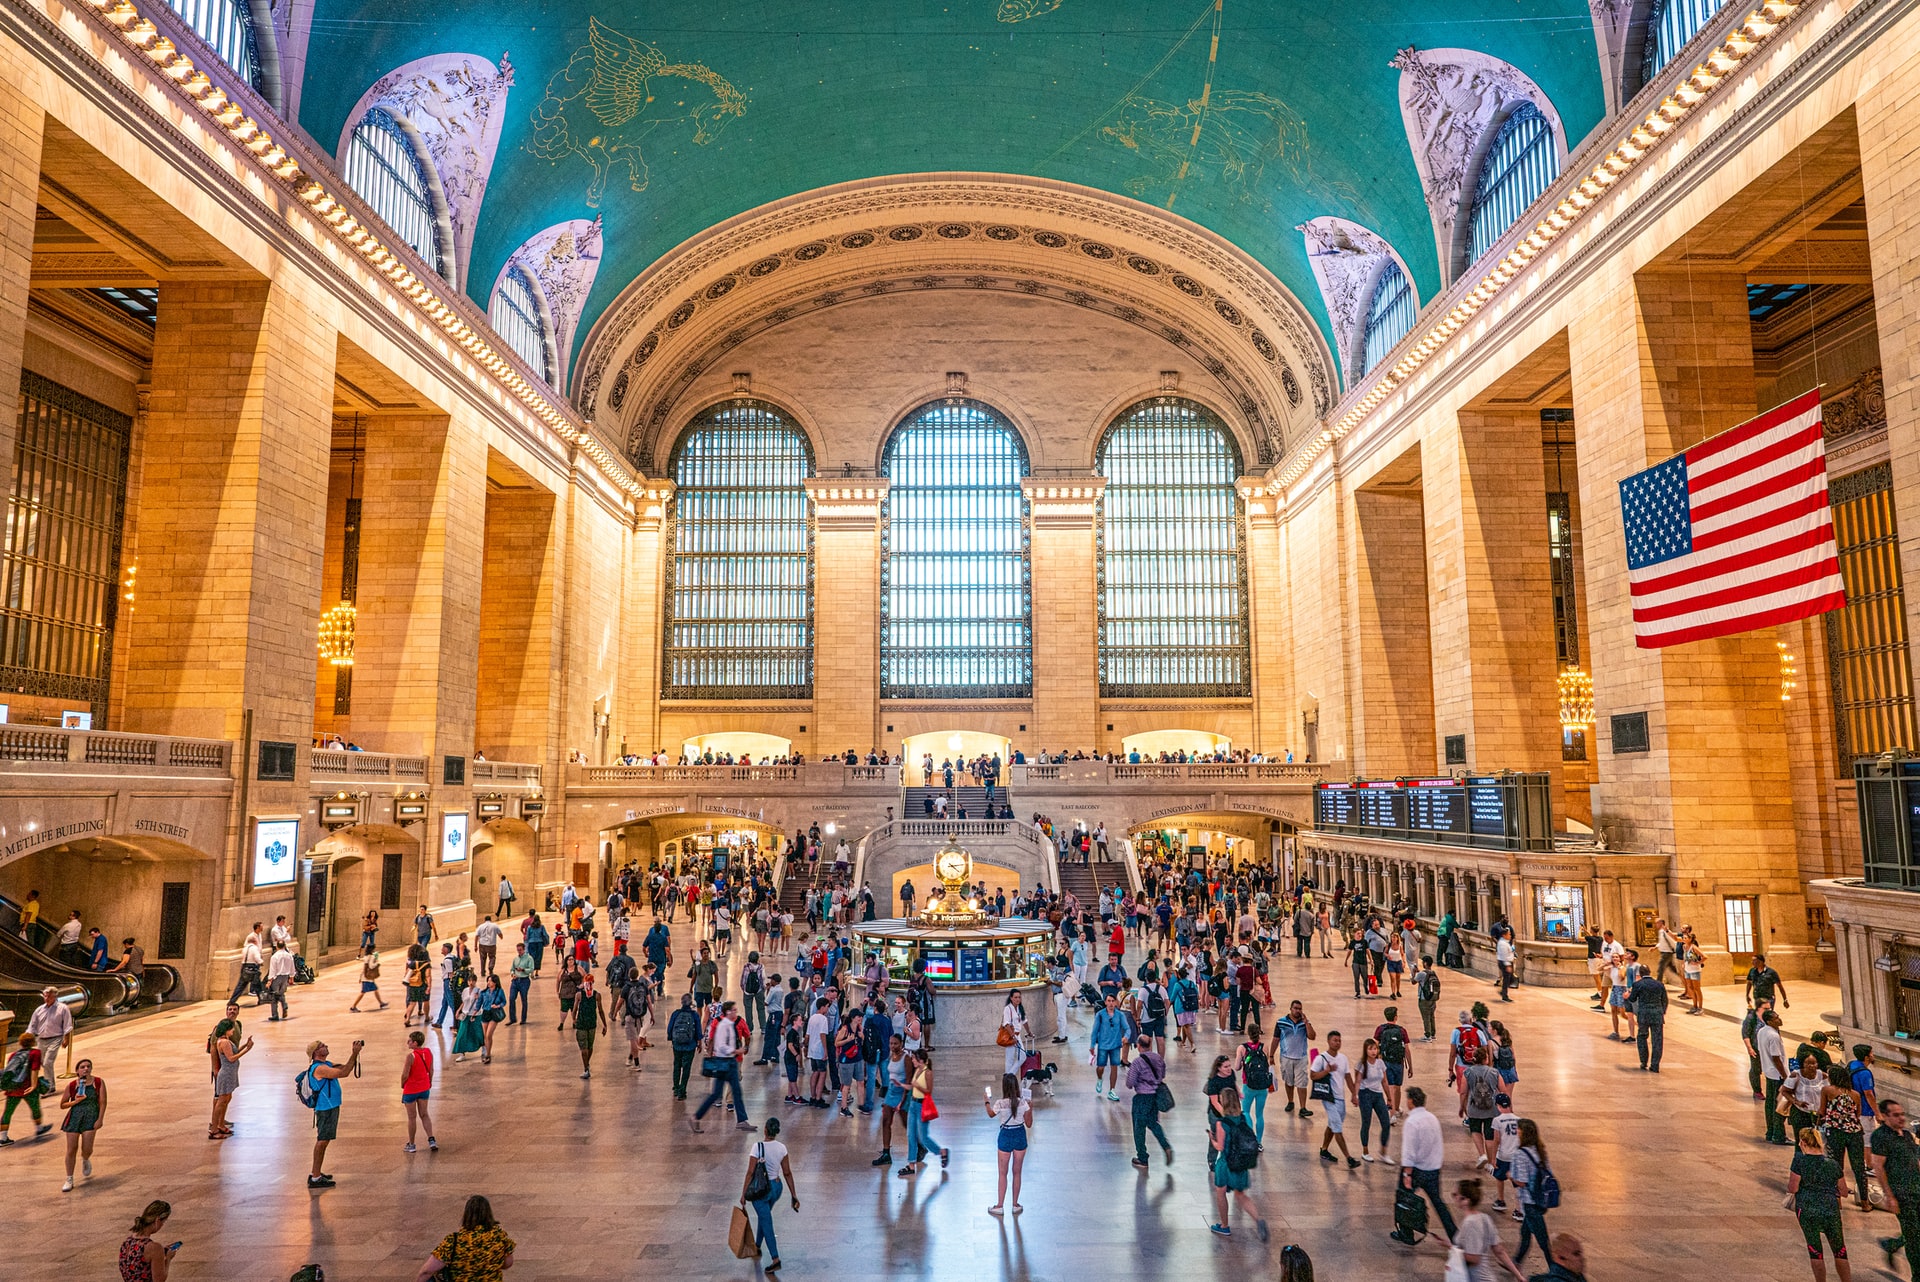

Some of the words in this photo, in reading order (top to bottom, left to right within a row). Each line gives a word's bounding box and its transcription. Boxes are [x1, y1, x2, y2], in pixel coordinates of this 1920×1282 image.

[628, 808, 655, 819] TRACKS
[705, 804, 747, 816] LEXINGTON
[748, 811, 762, 820] AVE
[1151, 804, 1193, 818] LEXINGTON
[1194, 802, 1208, 810] AVE
[1232, 802, 1256, 810] TICKET
[1259, 805, 1295, 819] MACHINES
[135, 819, 157, 832] 45TH
[158, 821, 190, 839] STREET
[5, 829, 53, 857] METLIFE
[55, 819, 104, 839] BUILDING
[1505, 1123, 1517, 1136] 45
